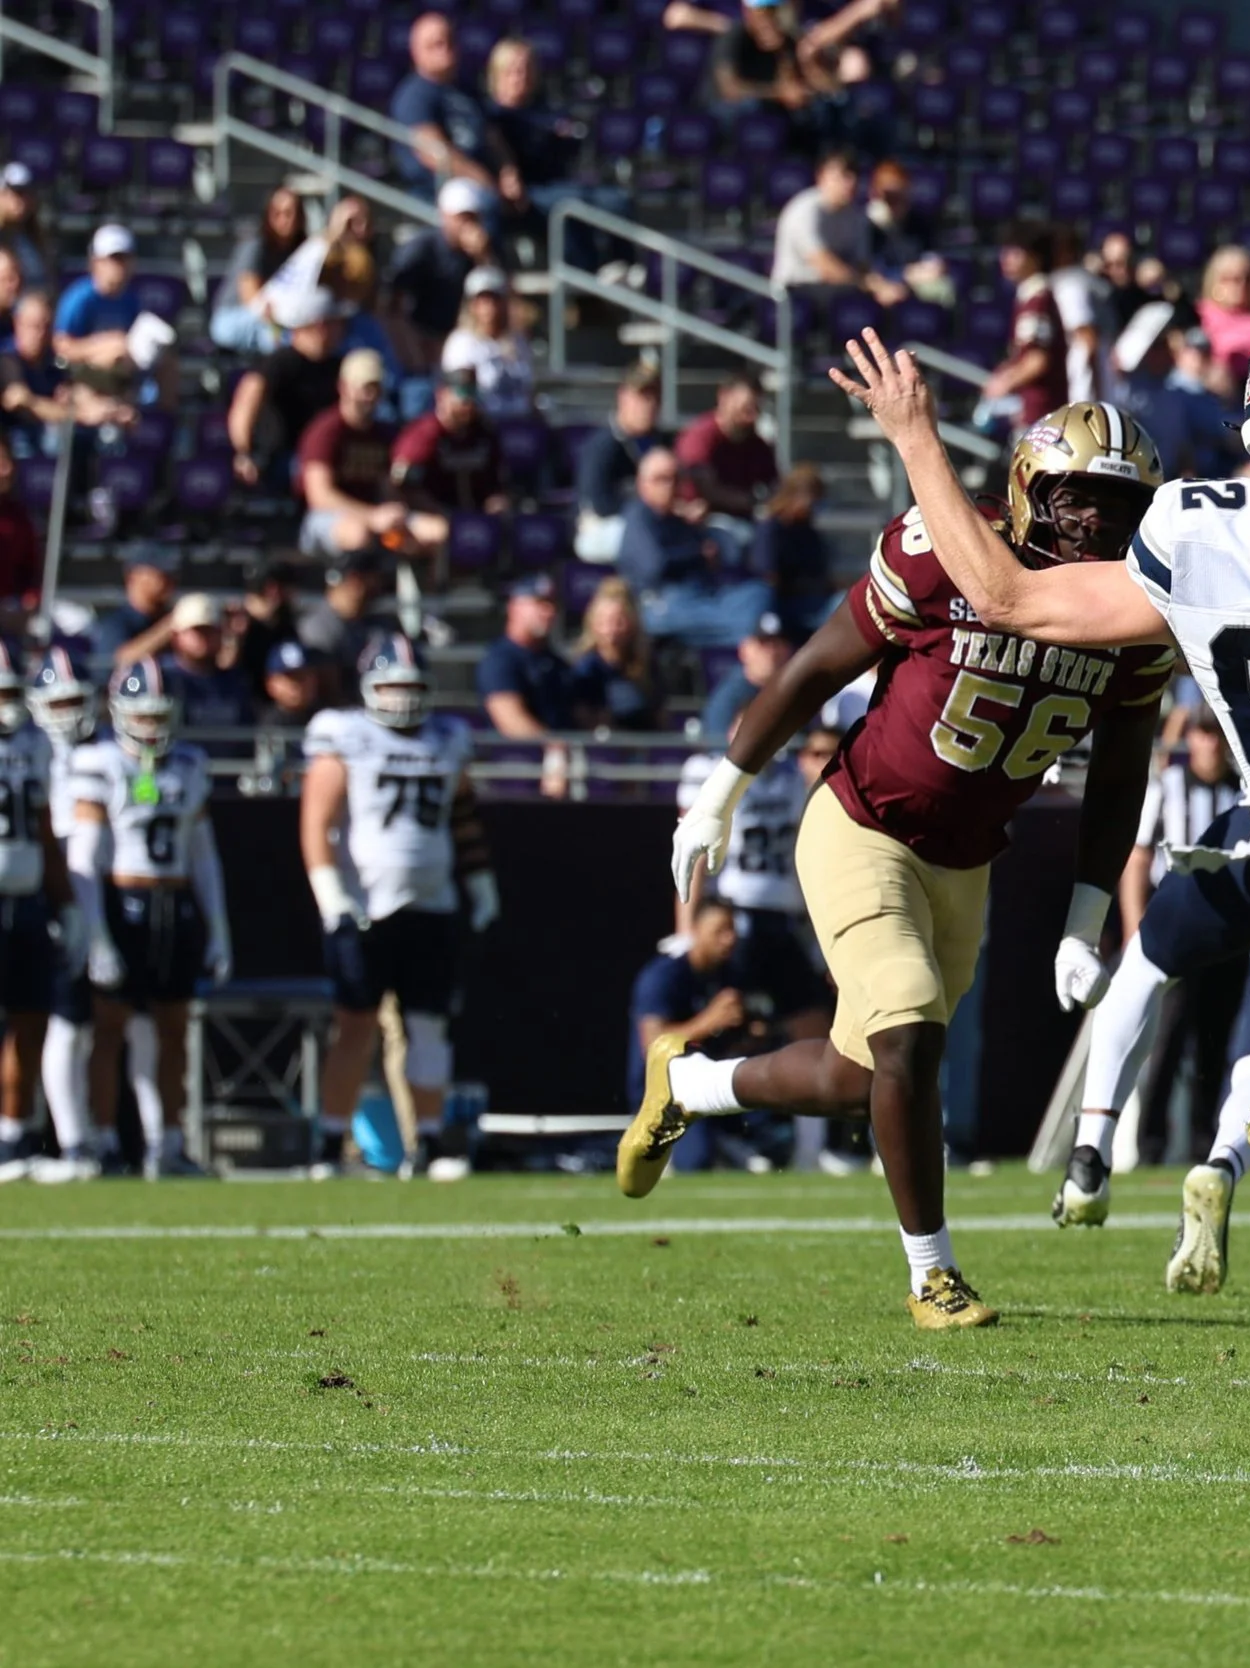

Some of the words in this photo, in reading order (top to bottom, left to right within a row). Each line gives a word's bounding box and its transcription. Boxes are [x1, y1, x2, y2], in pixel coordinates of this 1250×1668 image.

[1181, 479, 1246, 511] 2
[950, 627, 1037, 677] TEXAS
[1039, 646, 1115, 695] STATE
[930, 668, 1091, 780] 56
